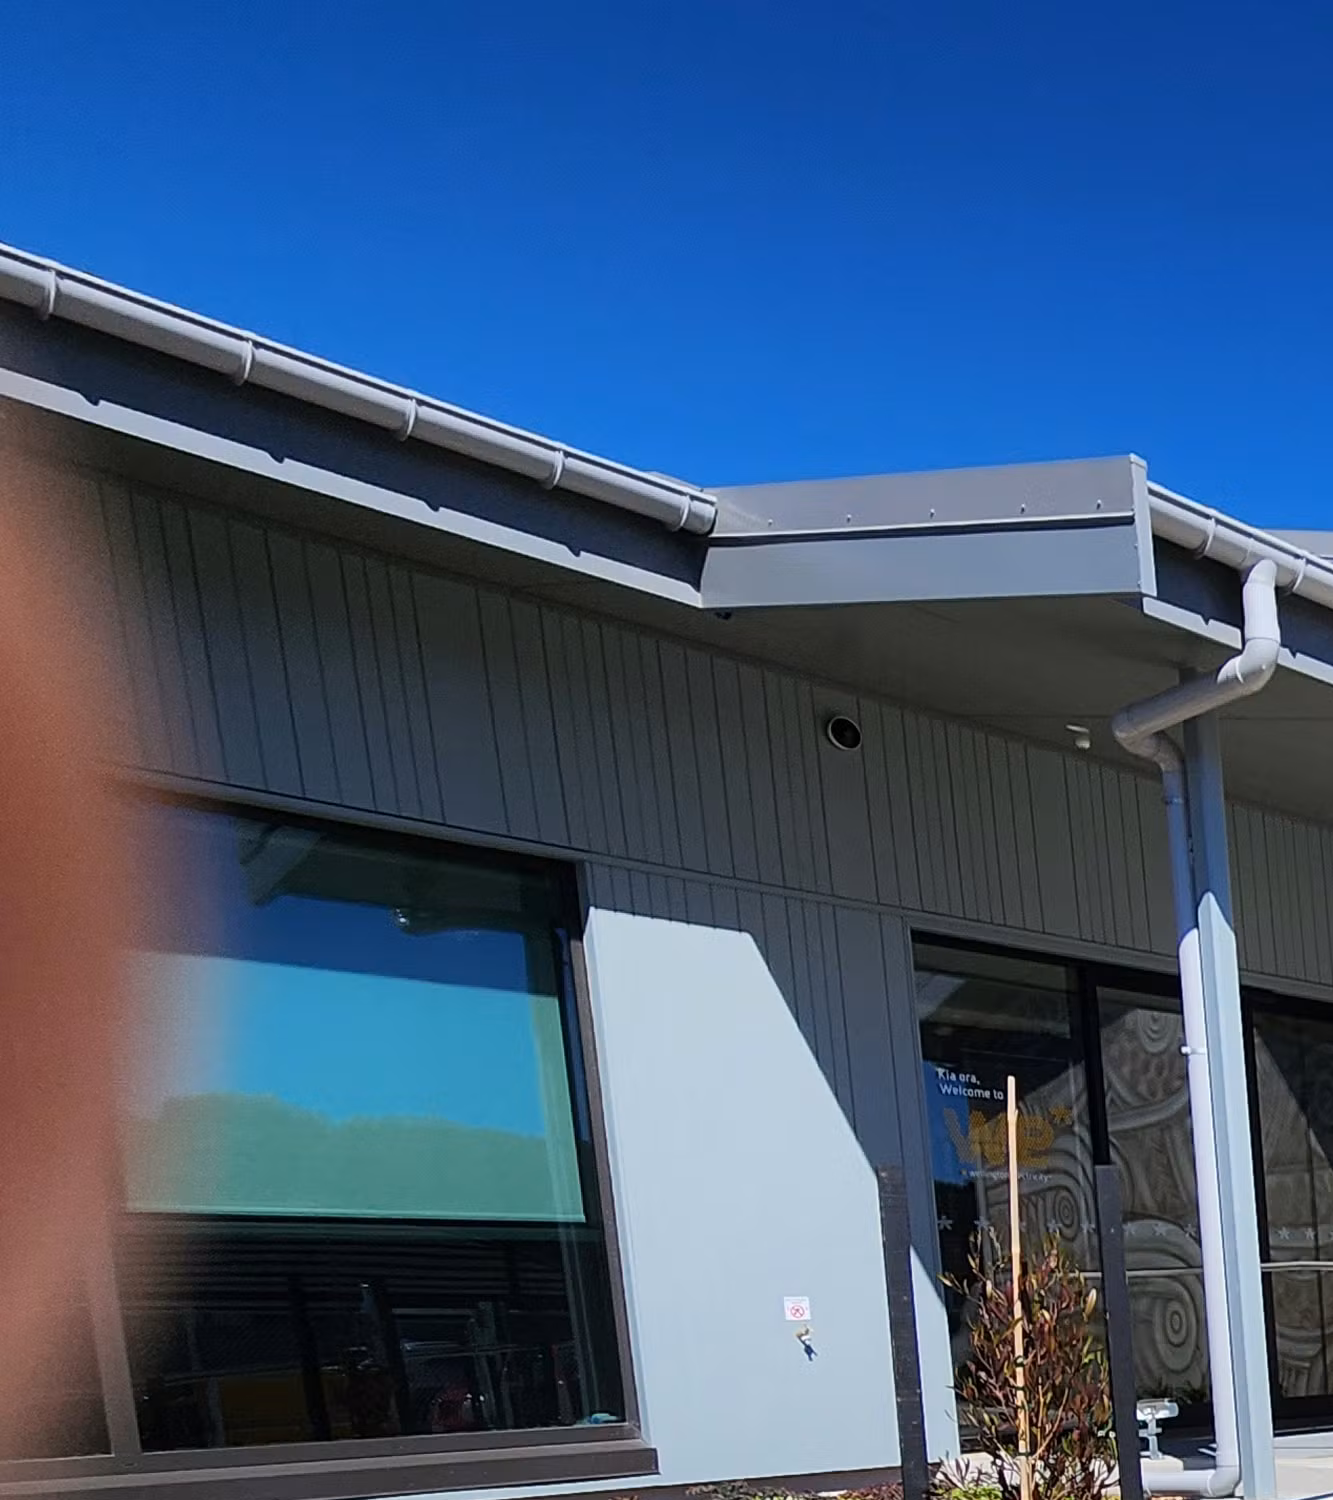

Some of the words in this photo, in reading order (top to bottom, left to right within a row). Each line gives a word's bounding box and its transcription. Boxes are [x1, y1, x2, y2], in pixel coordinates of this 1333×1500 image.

[936, 1067, 956, 1081] Kia
[959, 1073, 980, 1085] ora,
[940, 1083, 990, 1099] Welcome
[993, 1089, 1004, 1100] to
